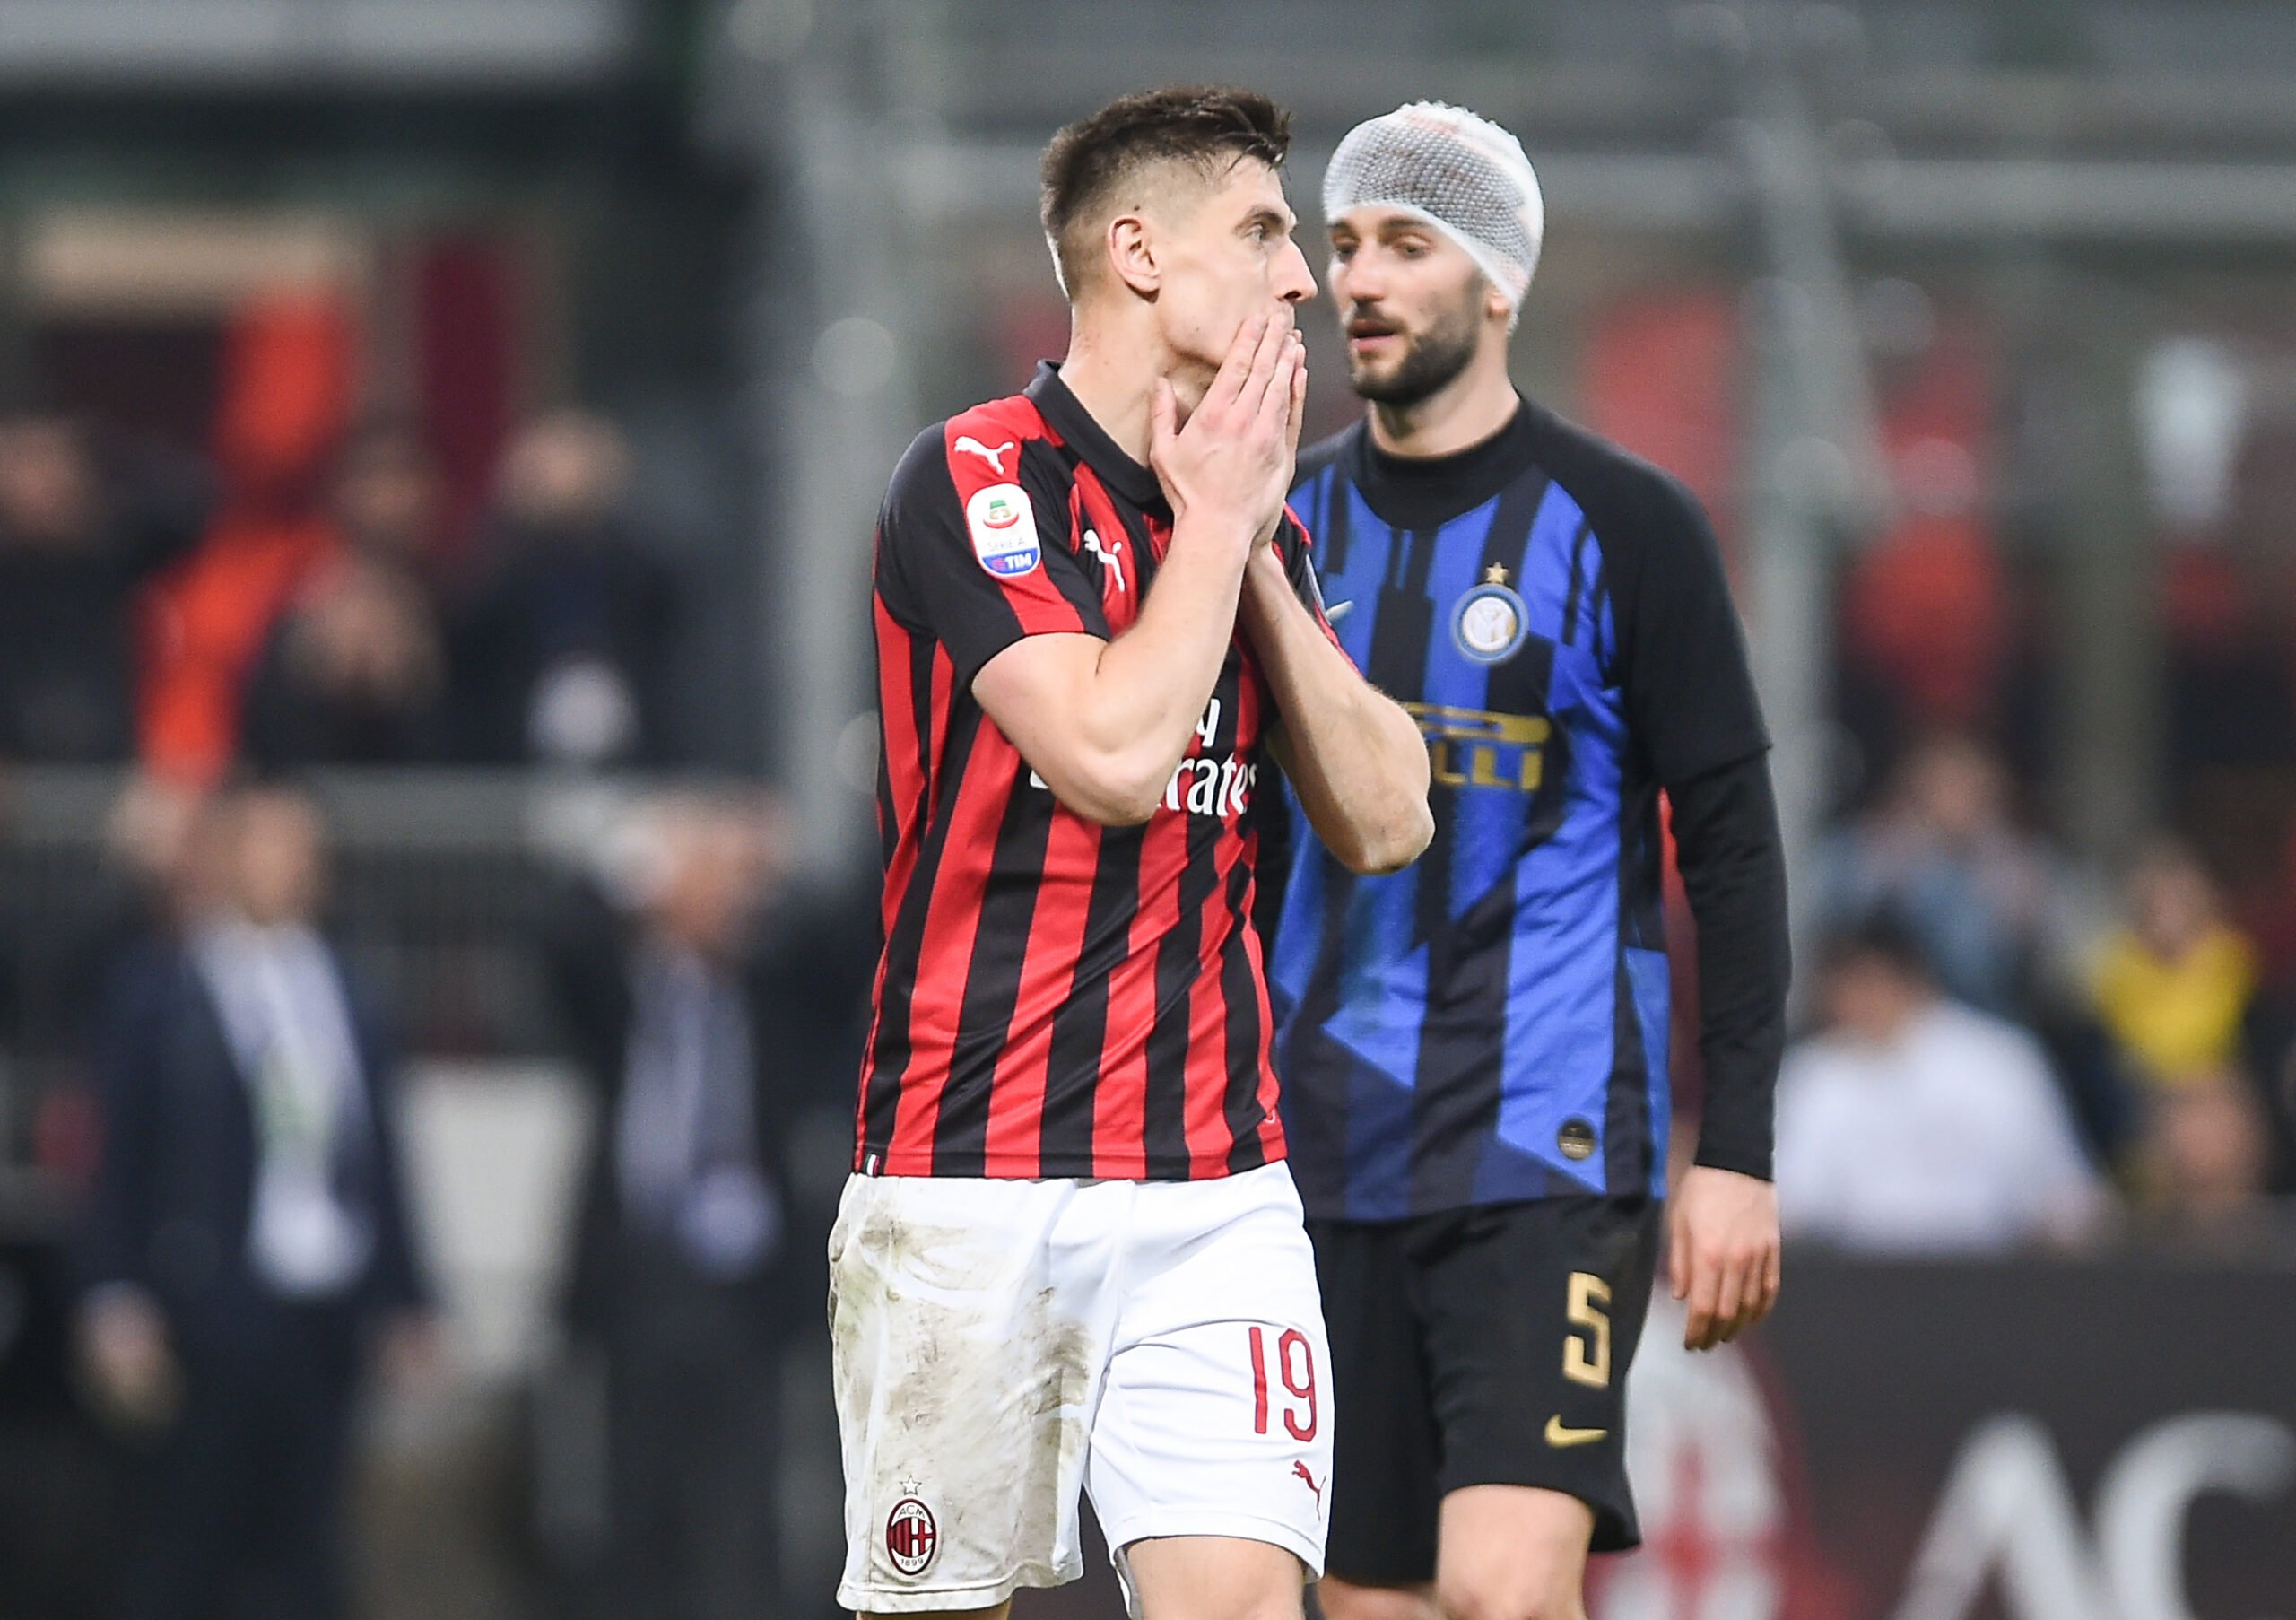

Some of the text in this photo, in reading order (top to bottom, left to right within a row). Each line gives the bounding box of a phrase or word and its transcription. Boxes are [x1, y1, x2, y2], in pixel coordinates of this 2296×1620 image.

[1004, 552, 1033, 570] TIM
[1563, 1271, 1612, 1388] 5
[1249, 1327, 1317, 1442] 19
[898, 1504, 926, 1519] ACM
